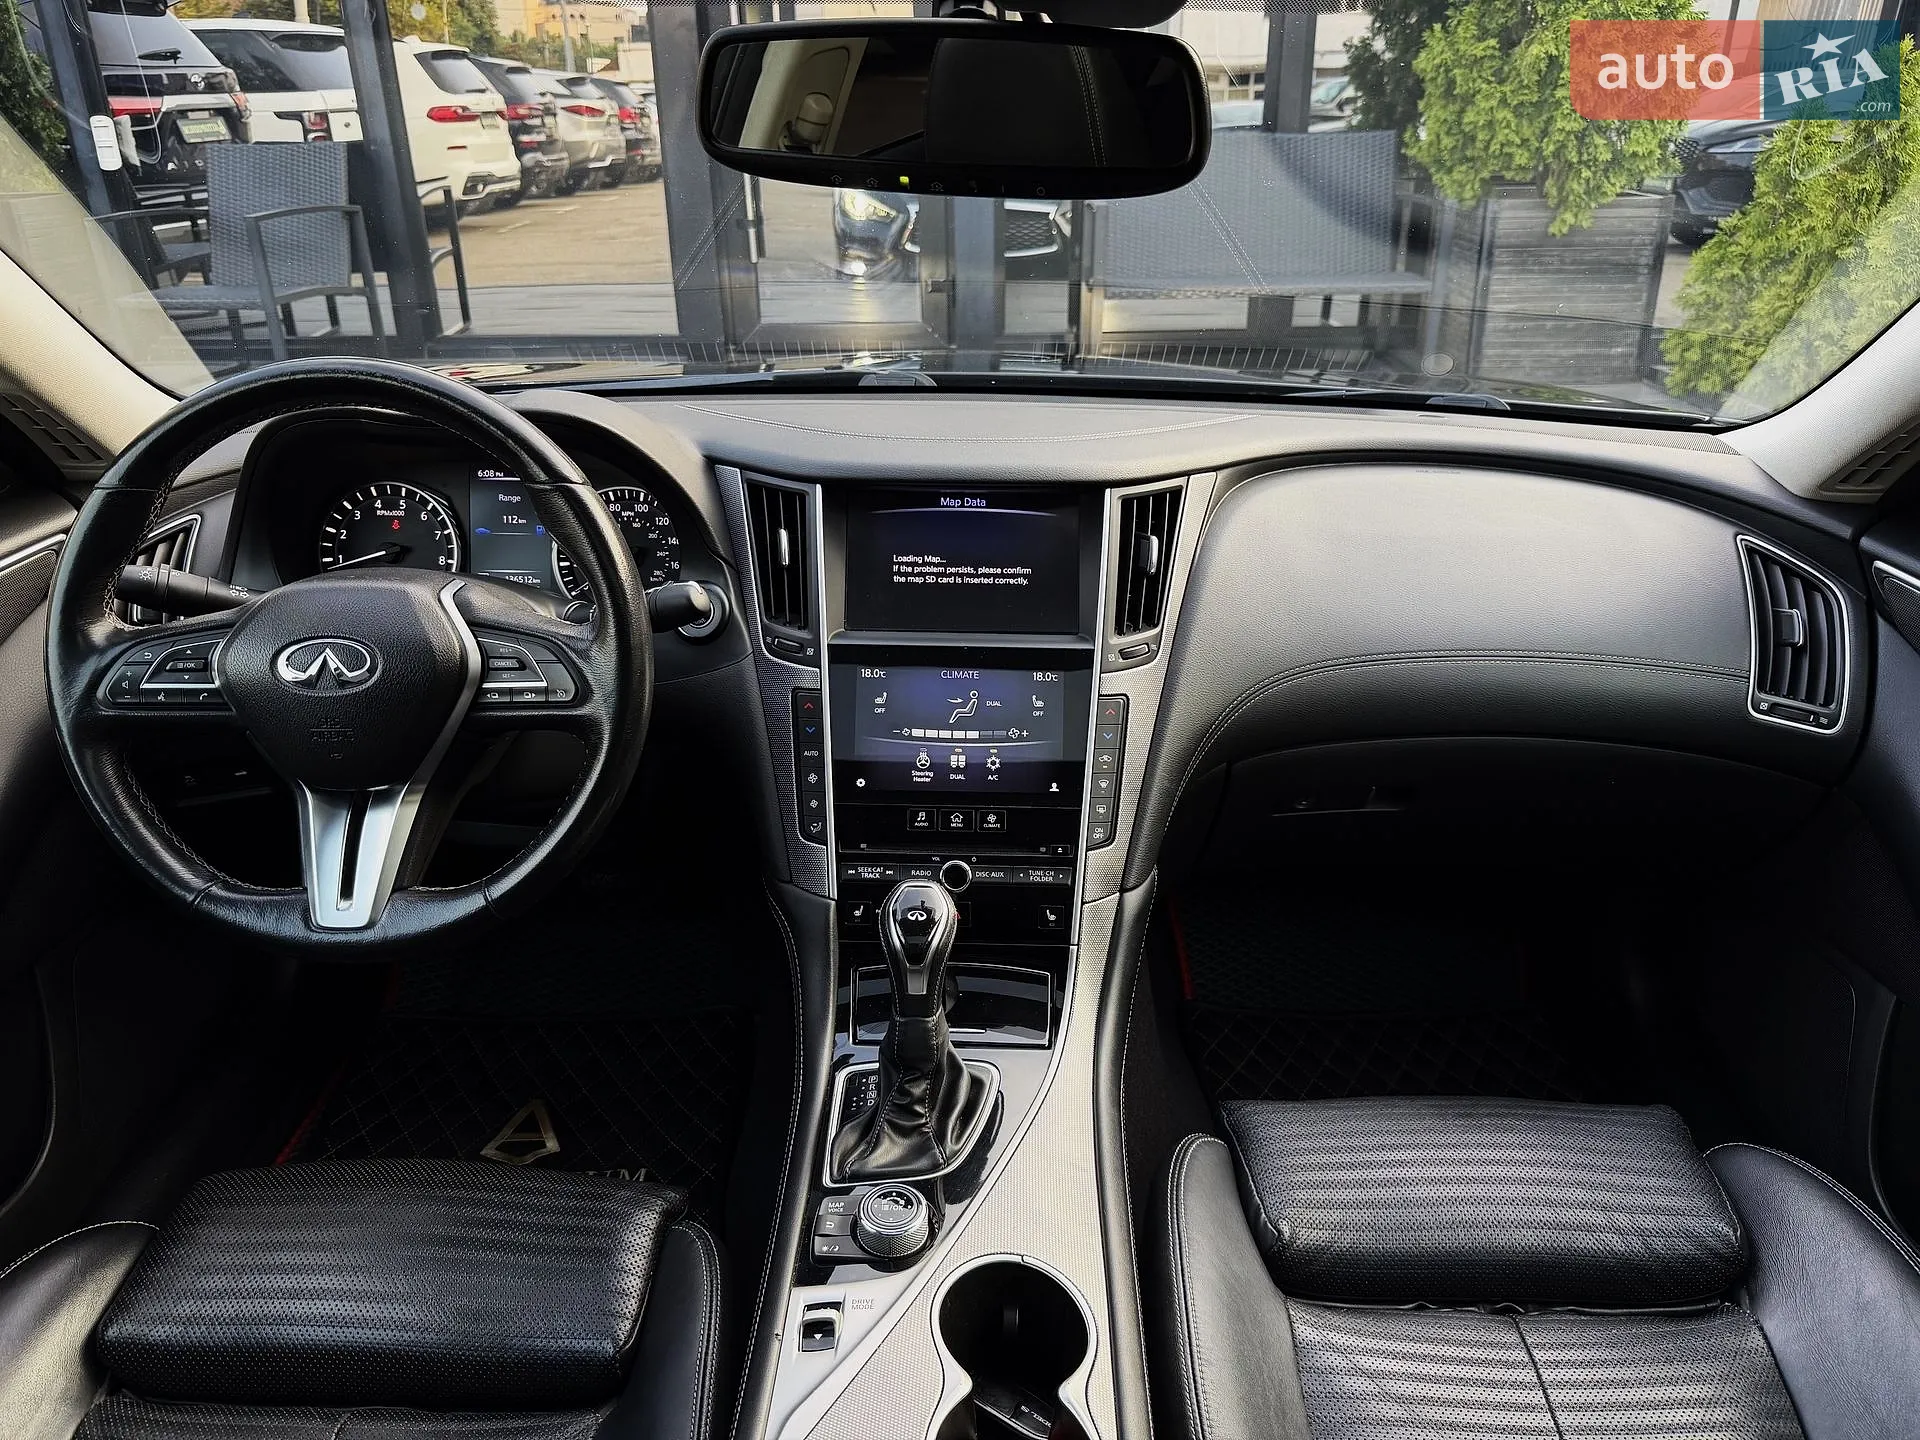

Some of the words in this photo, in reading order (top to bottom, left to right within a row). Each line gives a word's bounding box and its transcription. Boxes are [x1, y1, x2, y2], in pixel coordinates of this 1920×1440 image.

[477, 469, 495, 478] 6:08
[498, 493, 522, 503] Range
[940, 497, 962, 508] Map
[964, 497, 987, 507] Data
[374, 499, 382, 509] 4
[399, 499, 407, 509] 5
[609, 503, 621, 512] 80
[634, 503, 649, 513] 100
[354, 510, 361, 520] 3
[420, 511, 428, 521] 6
[503, 515, 518, 524] 112
[655, 517, 670, 526] 120
[340, 529, 347, 540] 2
[434, 530, 442, 541] 7
[338, 554, 343, 564] 1
[438, 555, 446, 566] 8
[893, 554, 923, 564] Loading
[900, 565, 913, 573] the
[914, 565, 945, 574] problem
[946, 566, 977, 575] persists,
[978, 566, 1002, 575] please
[1003, 566, 1032, 574] confirm
[893, 575, 906, 583] the
[963, 576, 994, 584] inserted
[995, 577, 1029, 586] correctly.
[940, 670, 980, 679] CLIMATE
[911, 869, 932, 877] RADIO
[869, 1083, 876, 1091] R
